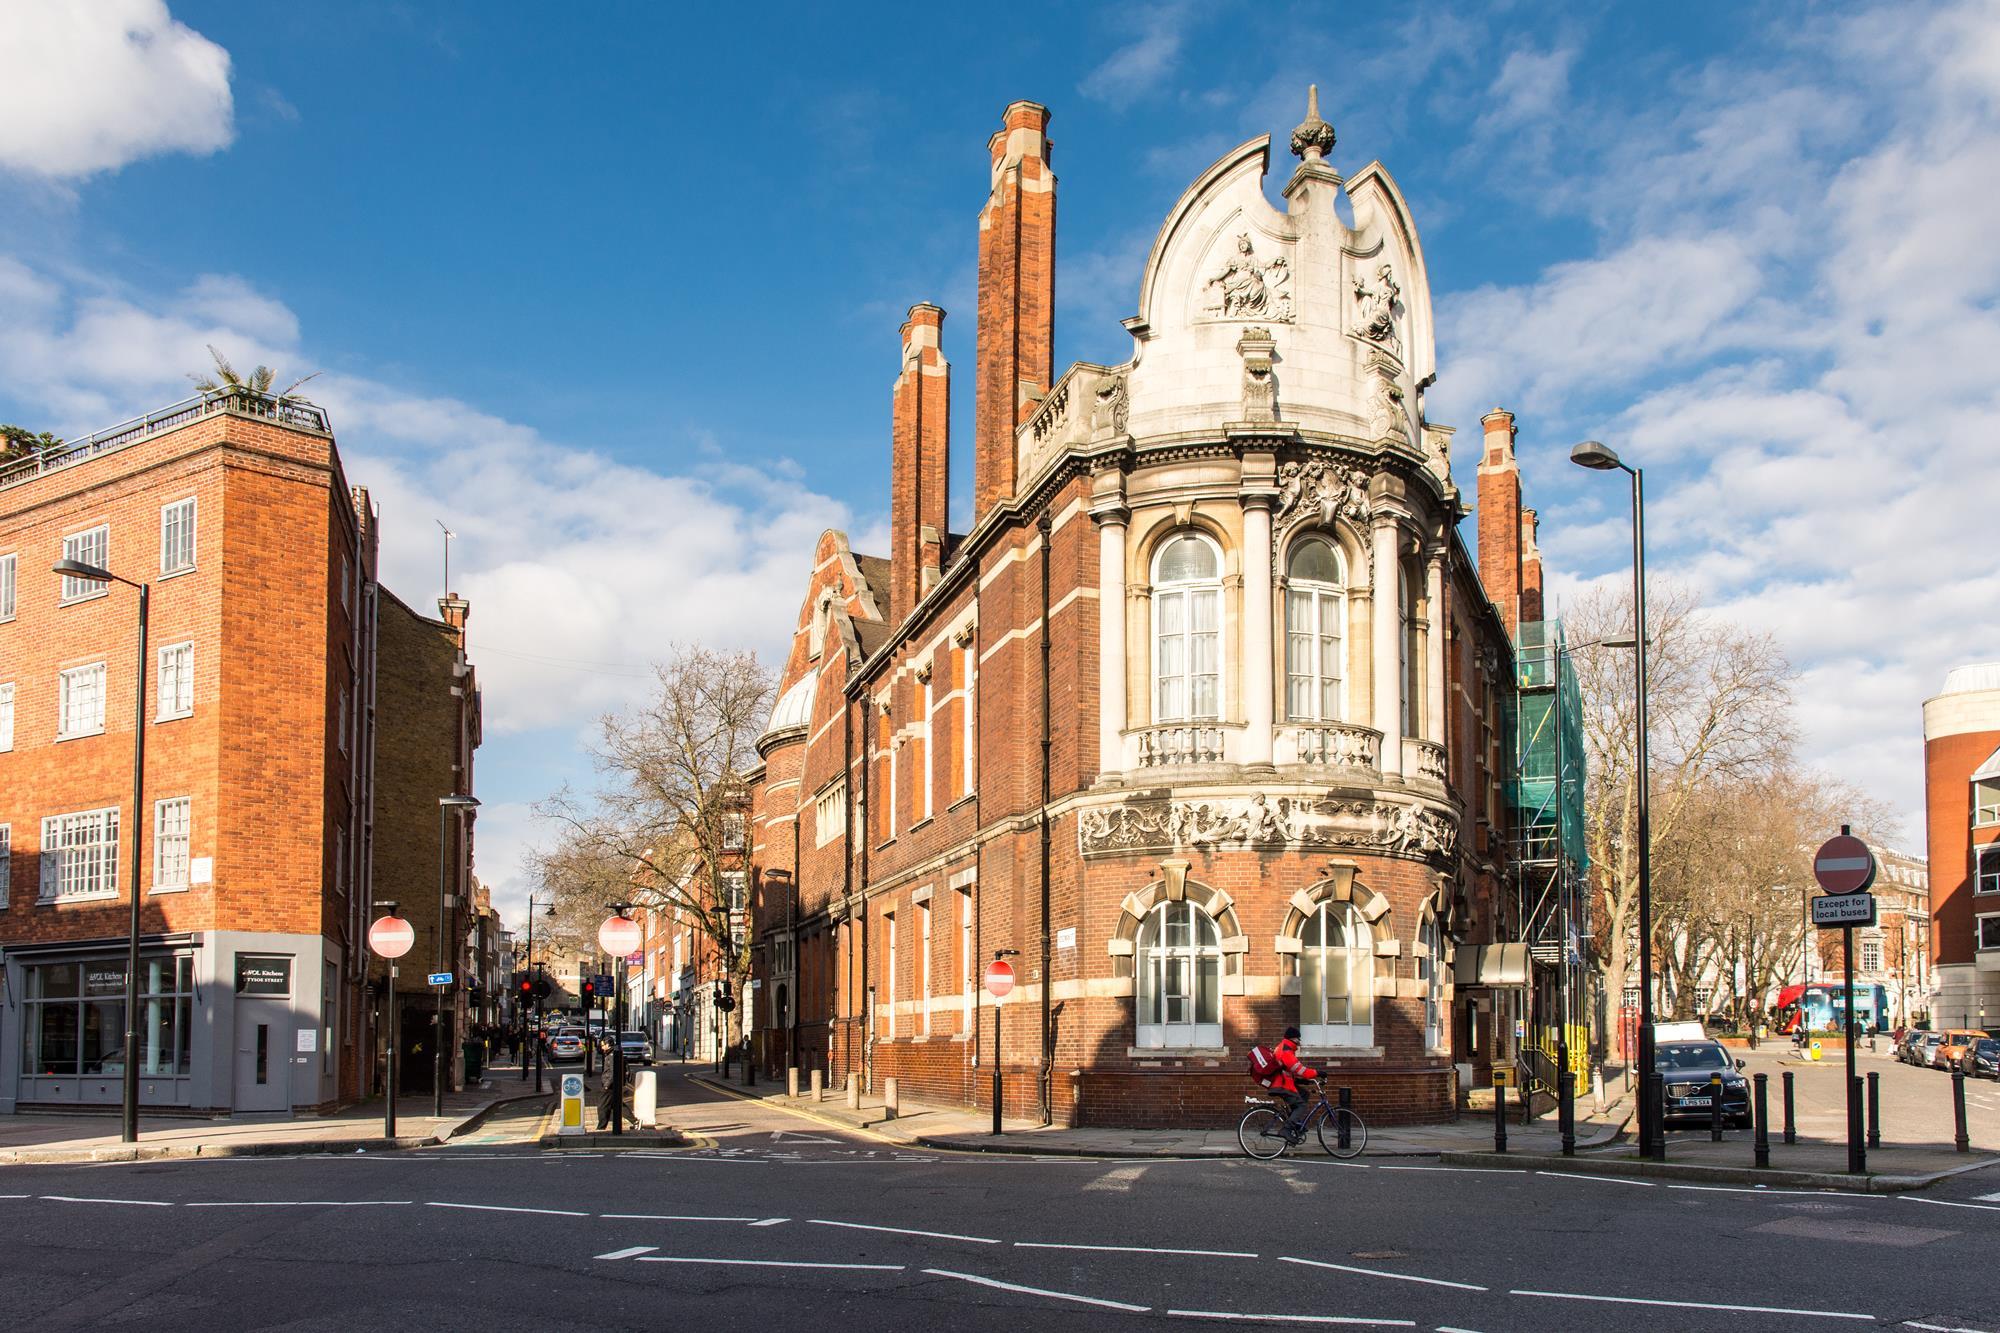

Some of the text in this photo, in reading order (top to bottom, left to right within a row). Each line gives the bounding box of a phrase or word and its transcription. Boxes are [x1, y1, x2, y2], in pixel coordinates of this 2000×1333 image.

[1818, 898, 1865, 908] Except for
[1816, 909, 1868, 918] local buses
